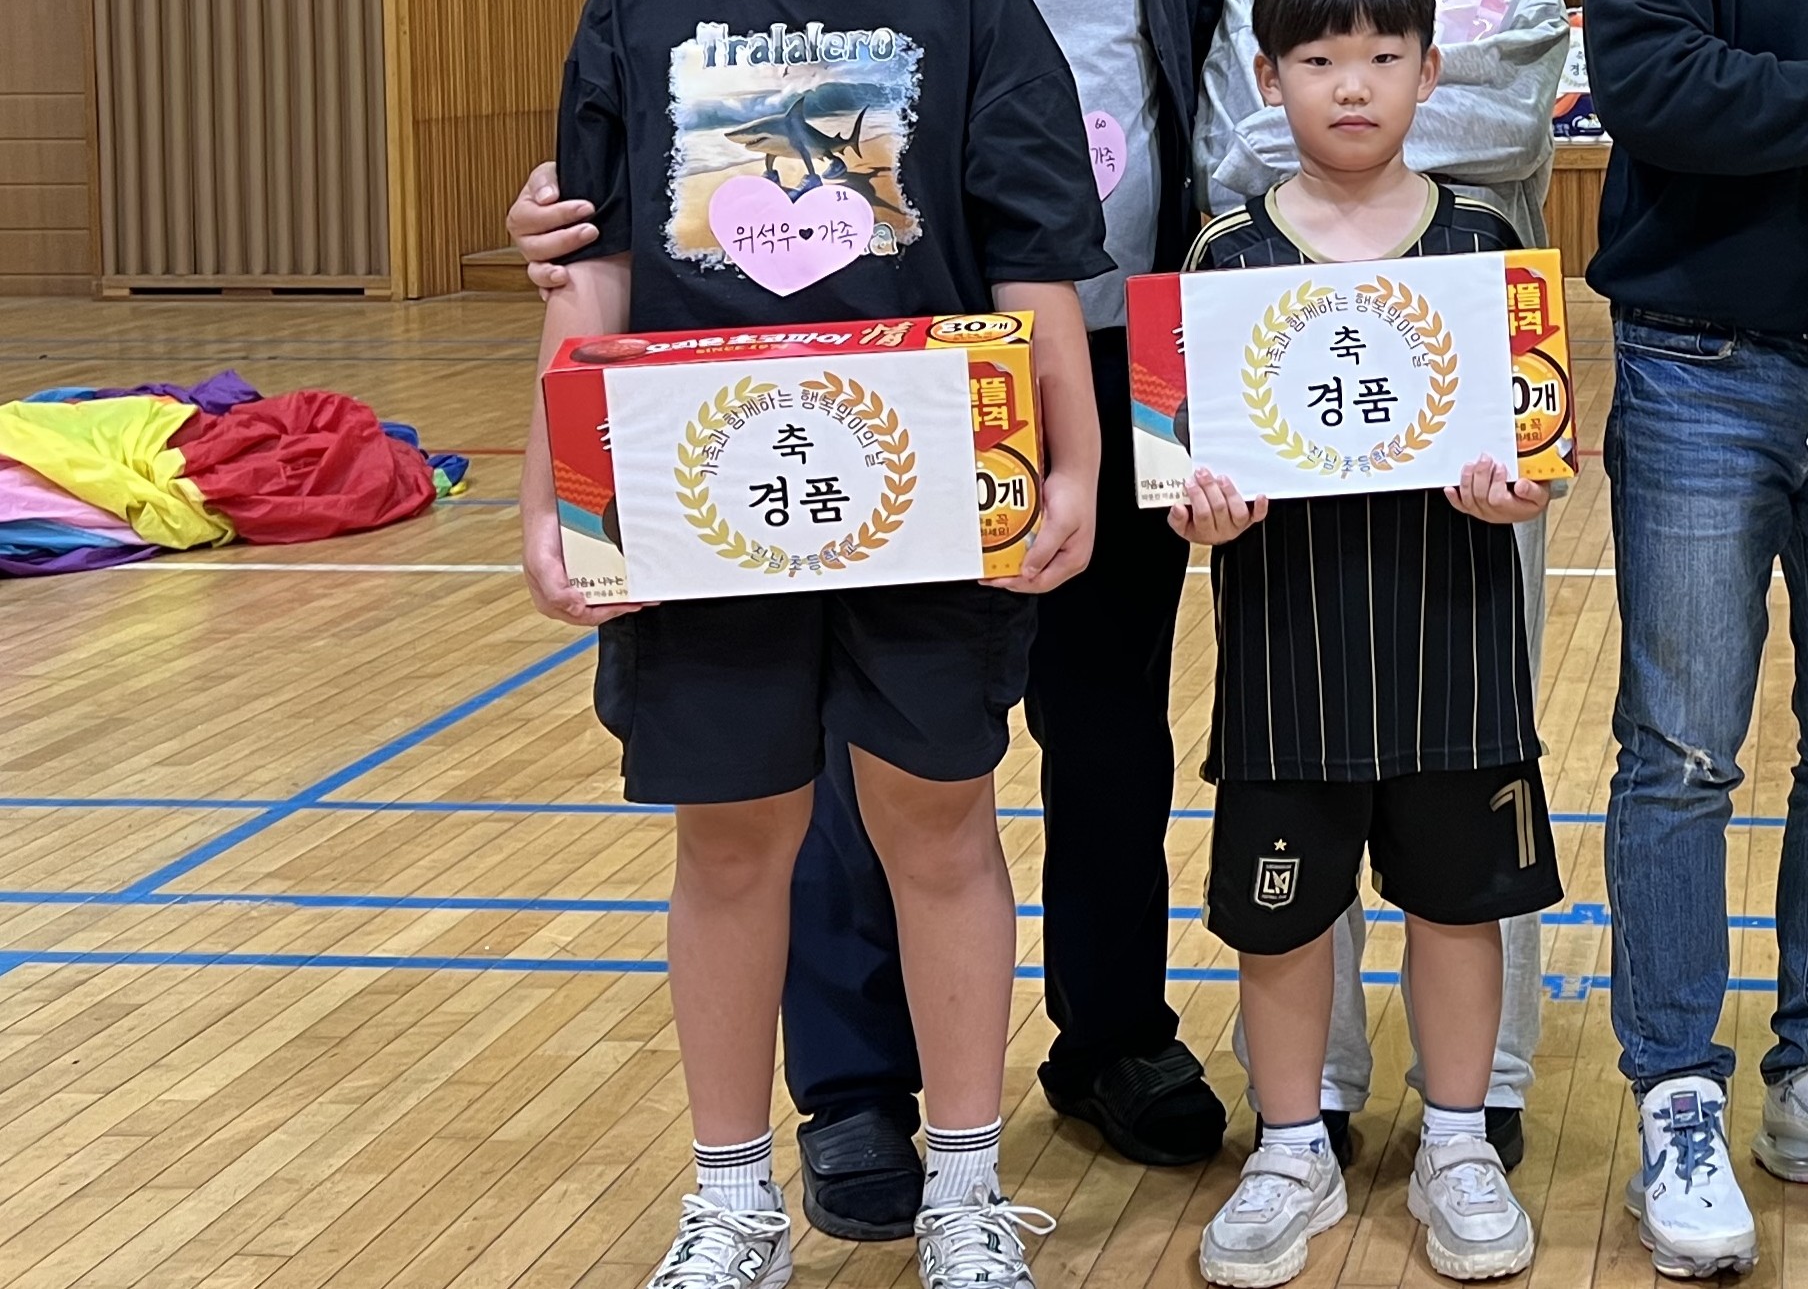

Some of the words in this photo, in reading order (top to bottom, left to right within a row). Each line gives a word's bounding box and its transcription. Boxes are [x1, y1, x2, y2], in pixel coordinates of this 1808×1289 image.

[1095, 118, 1106, 129] 60
[1090, 147, 1115, 172] 가족
[818, 220, 858, 249] 가족
[1285, 292, 1349, 333] 함께하는
[1329, 325, 1366, 365] 축
[1307, 376, 1399, 427] 경품
[1513, 375, 1556, 416] 0개
[700, 429, 730, 476] 가족과
[722, 389, 793, 431] 함께하는
[800, 389, 879, 450] 행복맞이의
[772, 423, 814, 465] 축
[748, 476, 850, 527] 경품
[976, 471, 1025, 511] 0개
